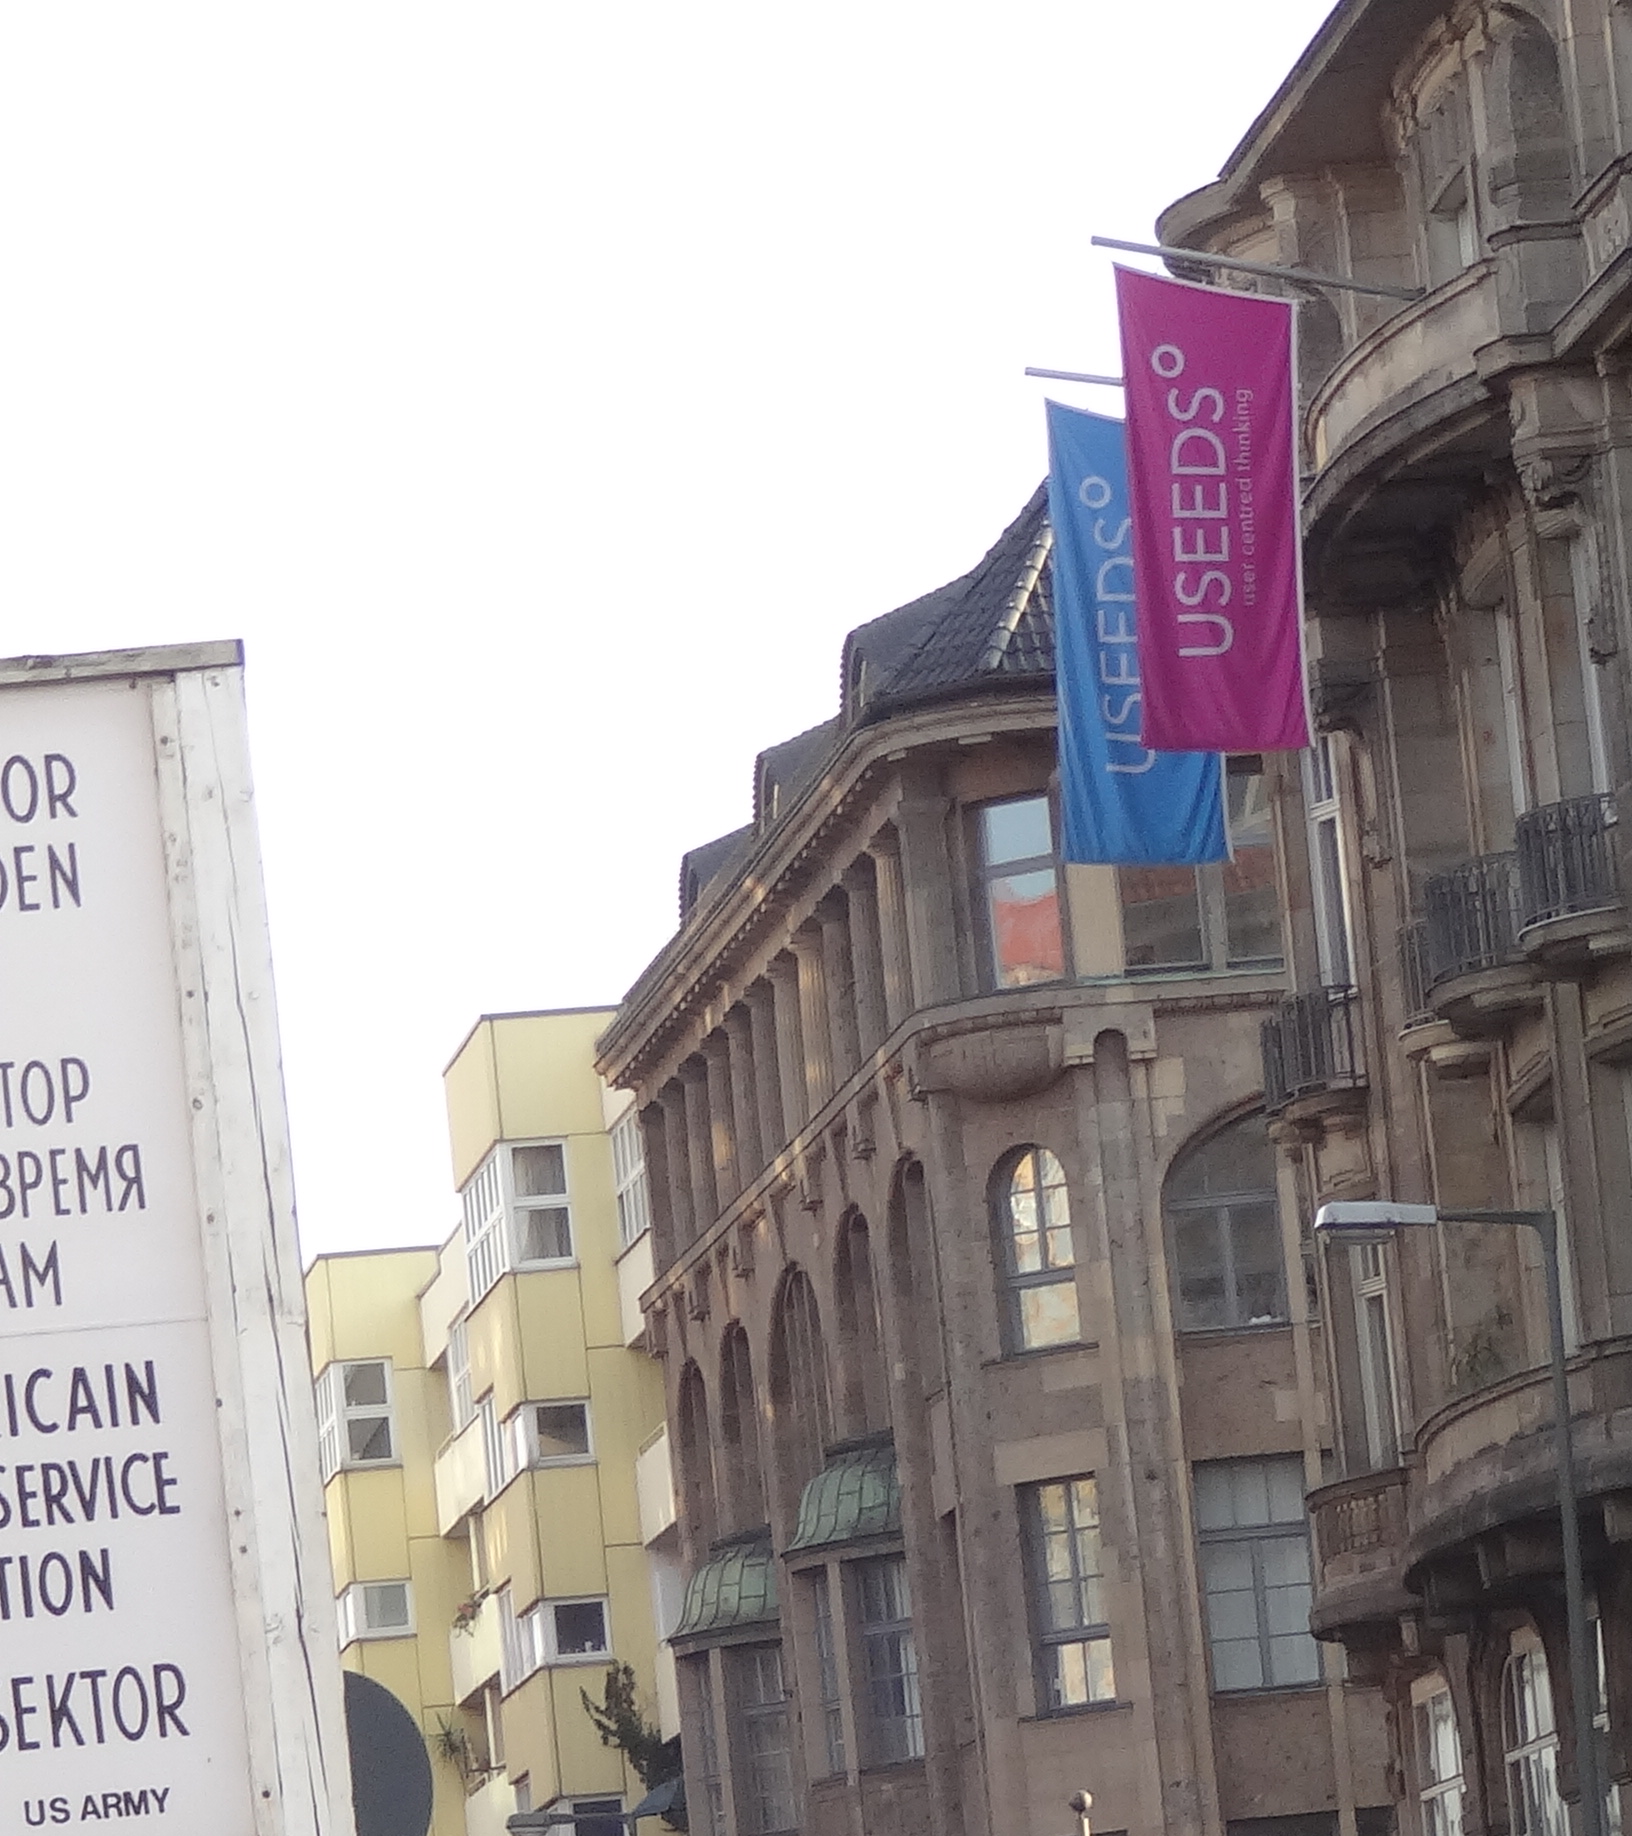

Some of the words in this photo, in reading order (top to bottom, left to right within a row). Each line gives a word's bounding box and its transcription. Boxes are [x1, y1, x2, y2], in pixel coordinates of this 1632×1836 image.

[1233, 388, 1254, 475] thinking
[22, 1795, 72, 1828] US
[79, 1786, 171, 1823] ARMY
